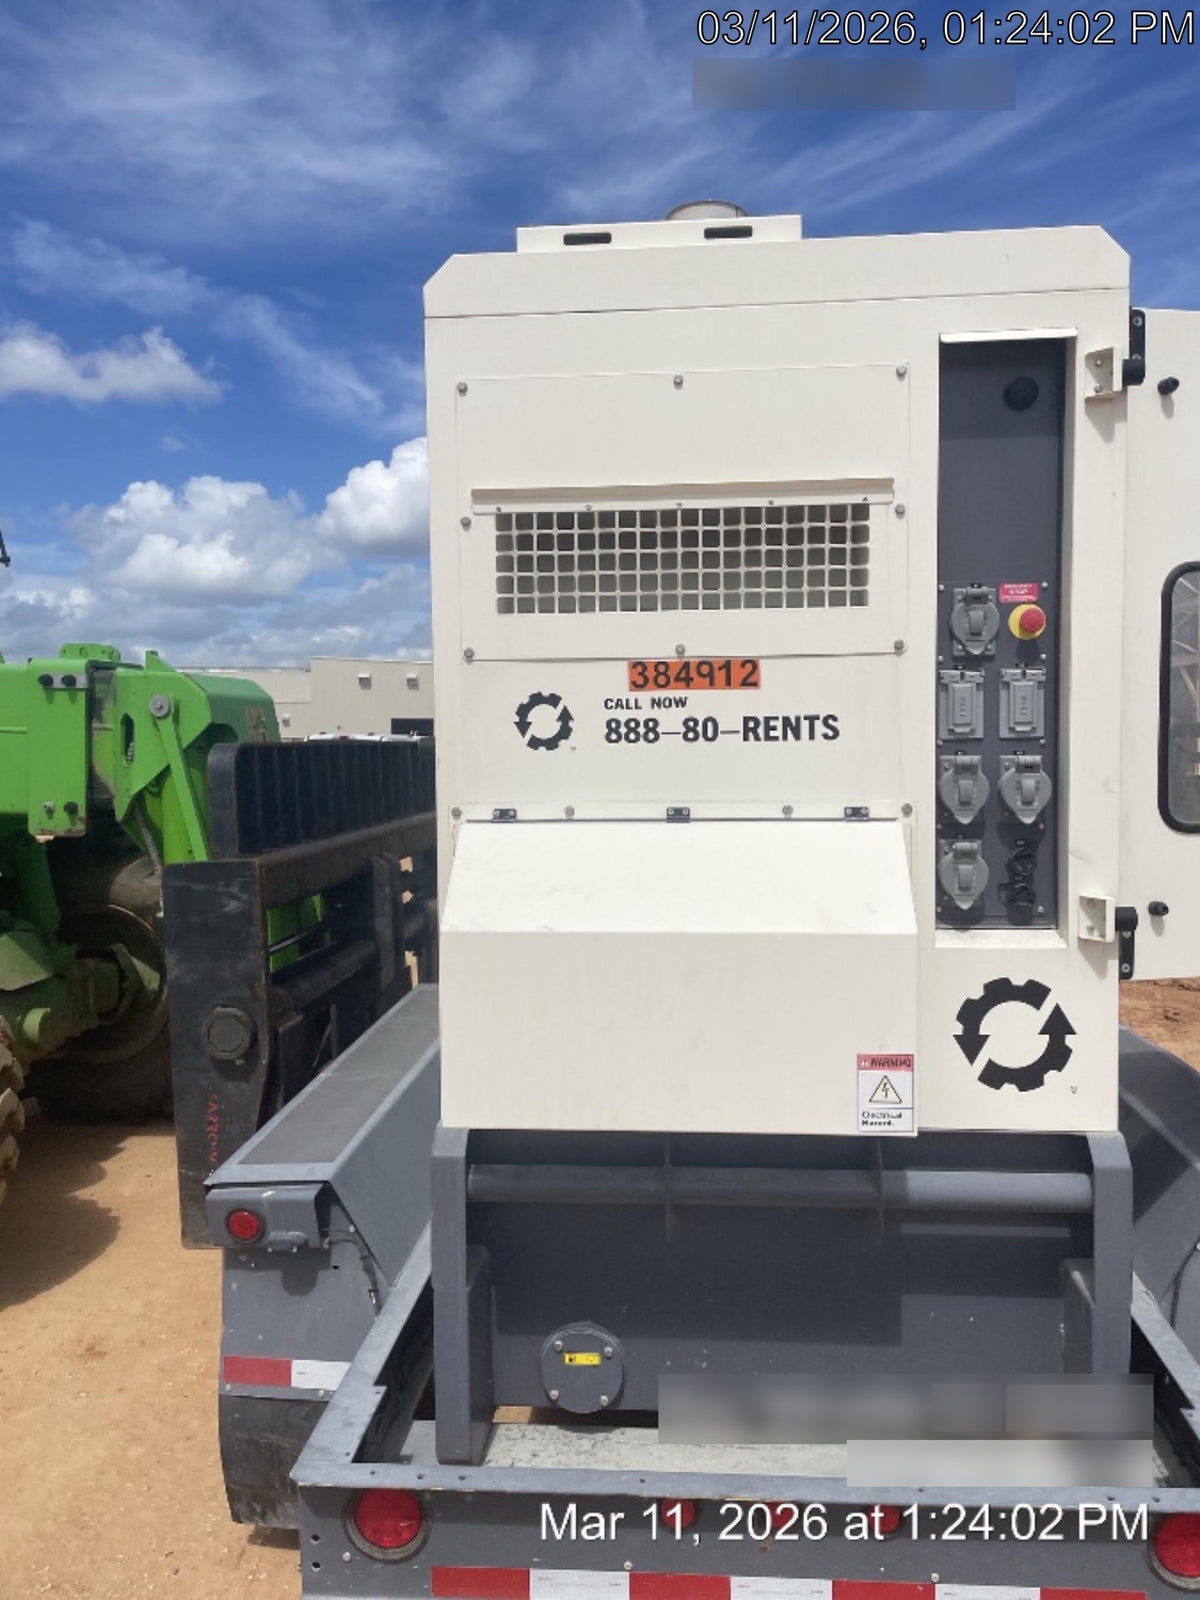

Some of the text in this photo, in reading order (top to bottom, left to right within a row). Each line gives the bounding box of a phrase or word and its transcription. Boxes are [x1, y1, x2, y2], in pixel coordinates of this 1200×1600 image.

[630, 659, 760, 689] 384912
[603, 695, 688, 711] CALL NOW
[603, 713, 840, 744] 888-80-RENTS
